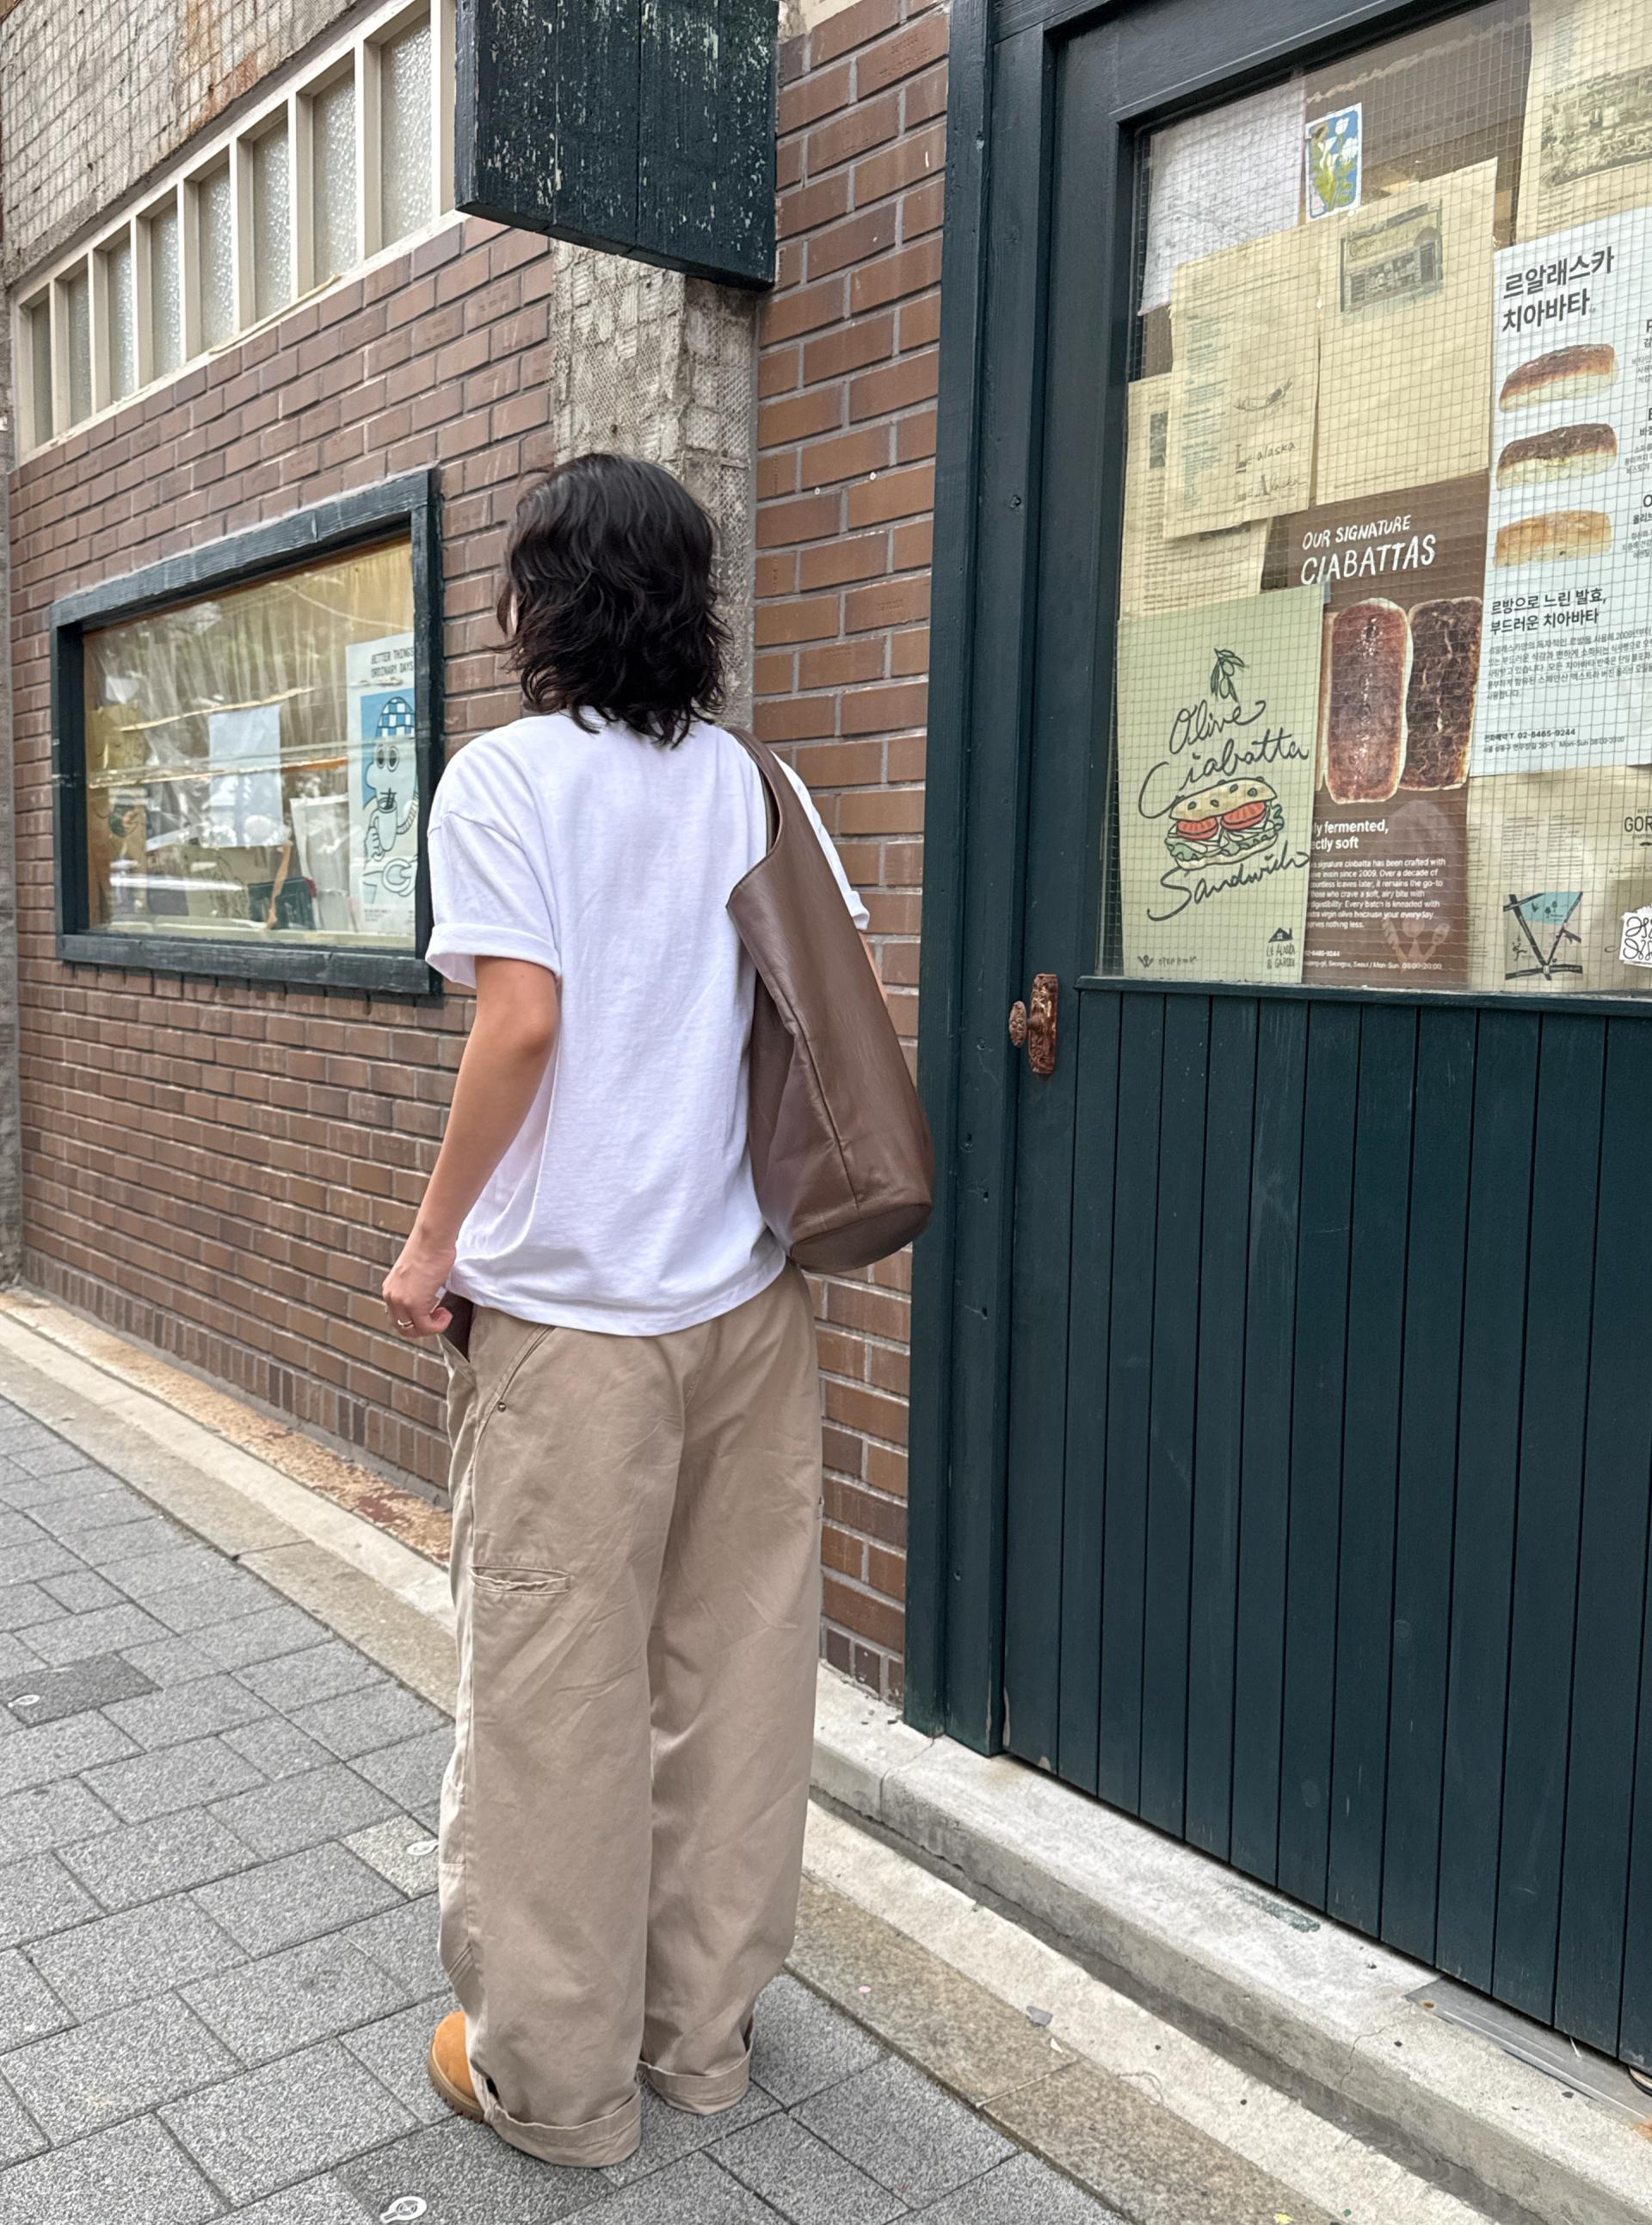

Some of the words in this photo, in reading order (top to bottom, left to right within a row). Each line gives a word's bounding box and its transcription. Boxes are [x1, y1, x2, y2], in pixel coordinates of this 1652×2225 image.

[1503, 246, 1615, 299] 르알래스카
[1501, 288, 1591, 332] 치아바타
[1257, 441, 1296, 462] alaska
[1302, 529, 1331, 551] OUR
[1335, 515, 1412, 544] SIGNATURE
[1300, 534, 1436, 585] CIABATTAS
[1490, 595, 1540, 615] 르방으로
[1543, 590, 1571, 608] 느린
[1575, 588, 1606, 606] 발효,
[1489, 614, 1539, 635] 부드러운
[1543, 607, 1600, 628] 치아바타
[1169, 700, 1267, 755] Olive
[1138, 727, 1310, 819] Ciabatta
[1324, 819, 1389, 834] fermented,
[1310, 837, 1333, 852] ectly
[1335, 836, 1359, 849] soft
[1404, 858, 1429, 866] crafted
[1146, 840, 1310, 921] Sandwich
[1422, 879, 1443, 889] go-to
[1345, 900, 1364, 909] Every
[1381, 890, 1394, 899] airy
